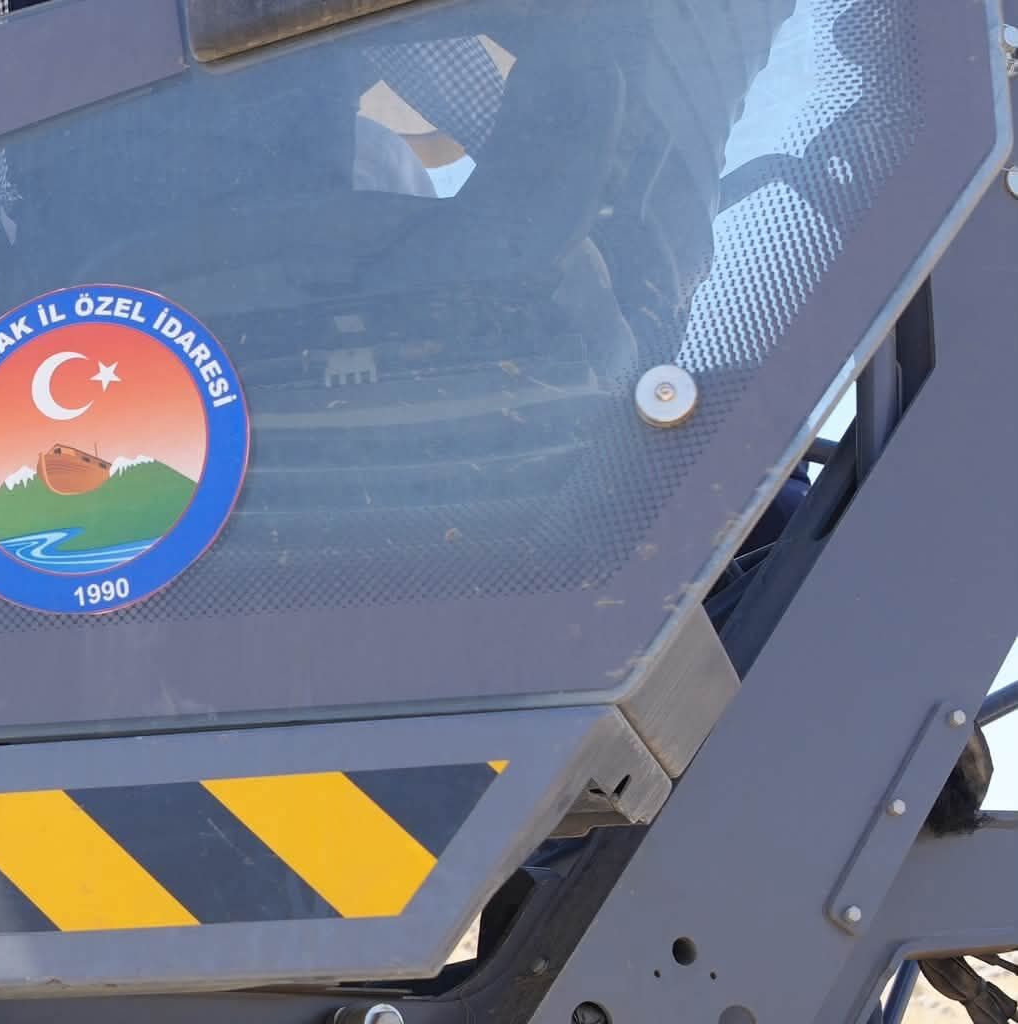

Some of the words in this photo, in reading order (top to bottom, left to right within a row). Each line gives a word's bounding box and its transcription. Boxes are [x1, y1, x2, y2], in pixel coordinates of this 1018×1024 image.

[37, 303, 66, 327] İL
[75, 293, 147, 323] ÖZEL
[152, 307, 237, 407] İDARESİ
[74, 577, 130, 606] 1990
